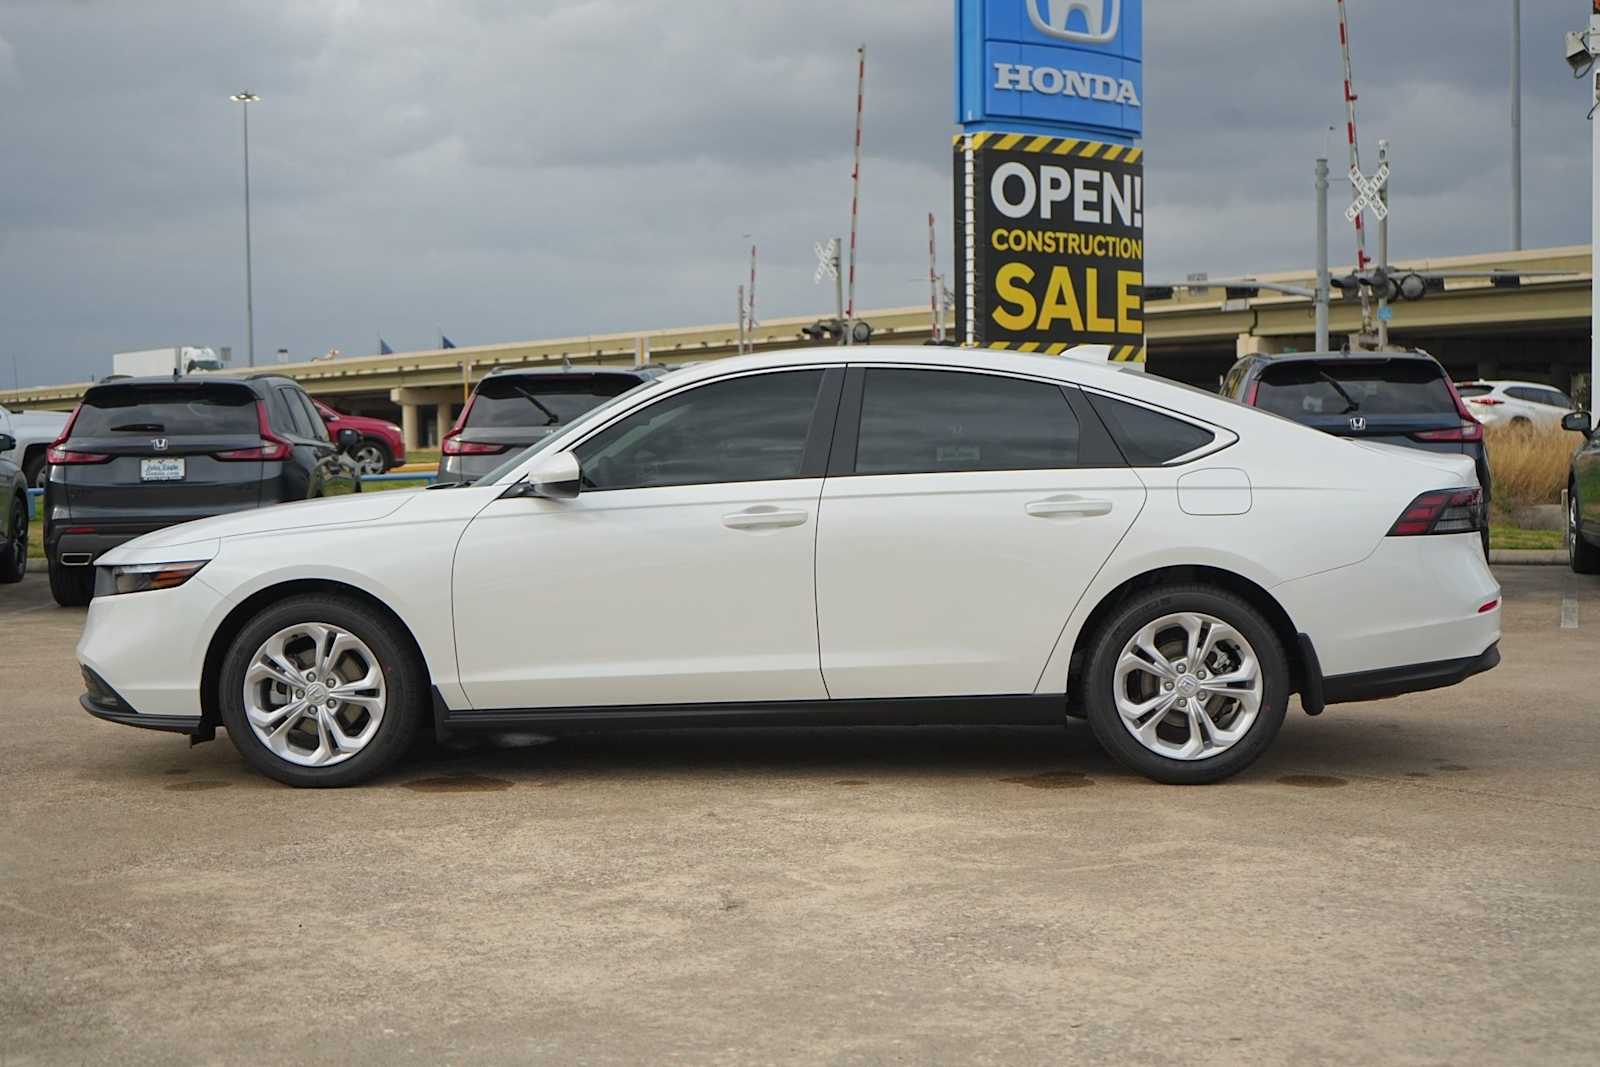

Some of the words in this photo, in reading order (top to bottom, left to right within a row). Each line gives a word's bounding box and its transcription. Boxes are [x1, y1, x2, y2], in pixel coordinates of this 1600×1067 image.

[993, 62, 1141, 106] HONDA
[990, 161, 1143, 228] OPEN!
[991, 228, 1142, 260] CONSTRUCTION
[991, 262, 1143, 334] SALE
